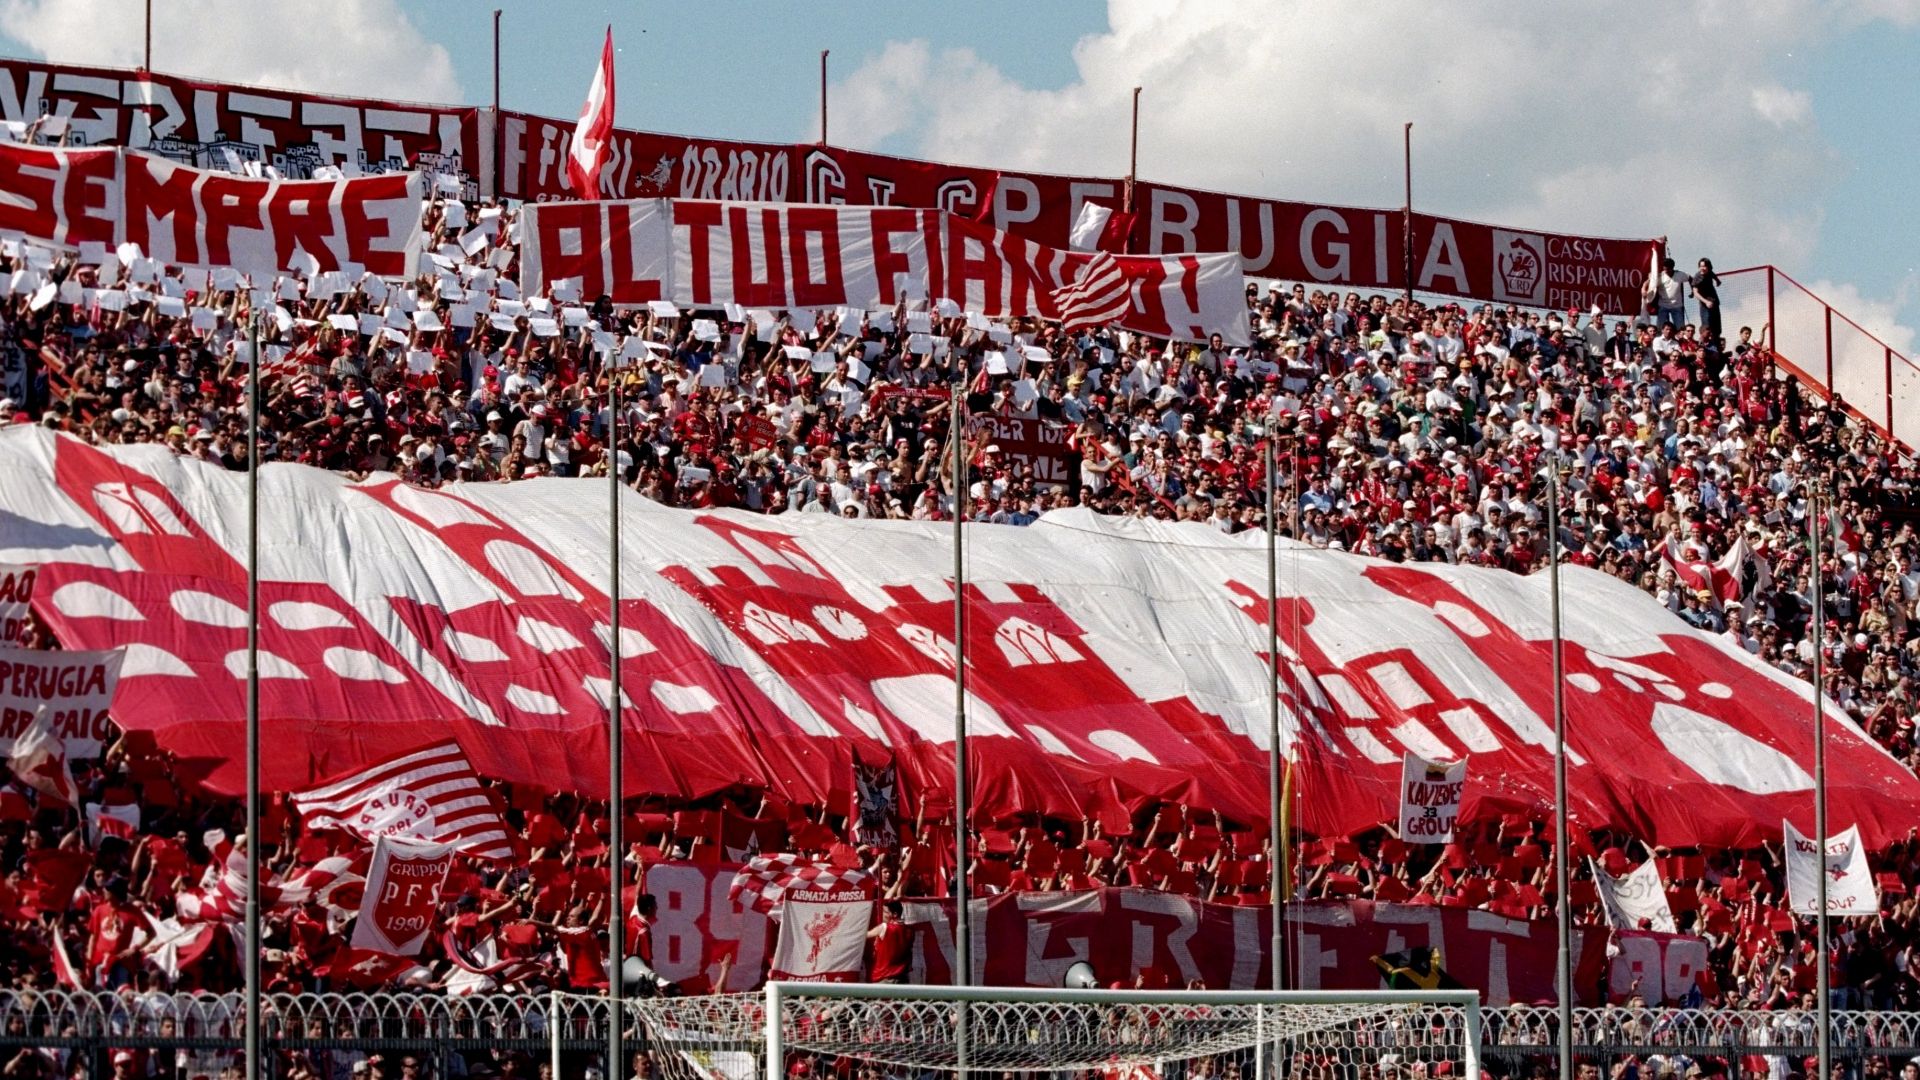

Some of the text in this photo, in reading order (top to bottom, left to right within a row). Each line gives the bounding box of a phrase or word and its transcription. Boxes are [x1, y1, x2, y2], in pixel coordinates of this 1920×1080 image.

[538, 124, 632, 199] FURI
[680, 144, 789, 203] ORARIO
[0, 147, 408, 275] SEMPRE
[537, 203, 661, 303] AL
[673, 201, 847, 307] TUO
[1547, 238, 1605, 262] CASSA
[1549, 262, 1643, 288] RISPARMIO
[1549, 287, 1624, 314] PERUGIA
[0, 660, 106, 700] PERUGIA
[1423, 807, 1437, 818] 33
[389, 862, 448, 877] GRUPPO
[792, 890, 866, 902] ARMATA ROSSA
[1808, 896, 1856, 911] GOUP
[384, 915, 425, 931] 1990
[646, 863, 767, 991] 89
